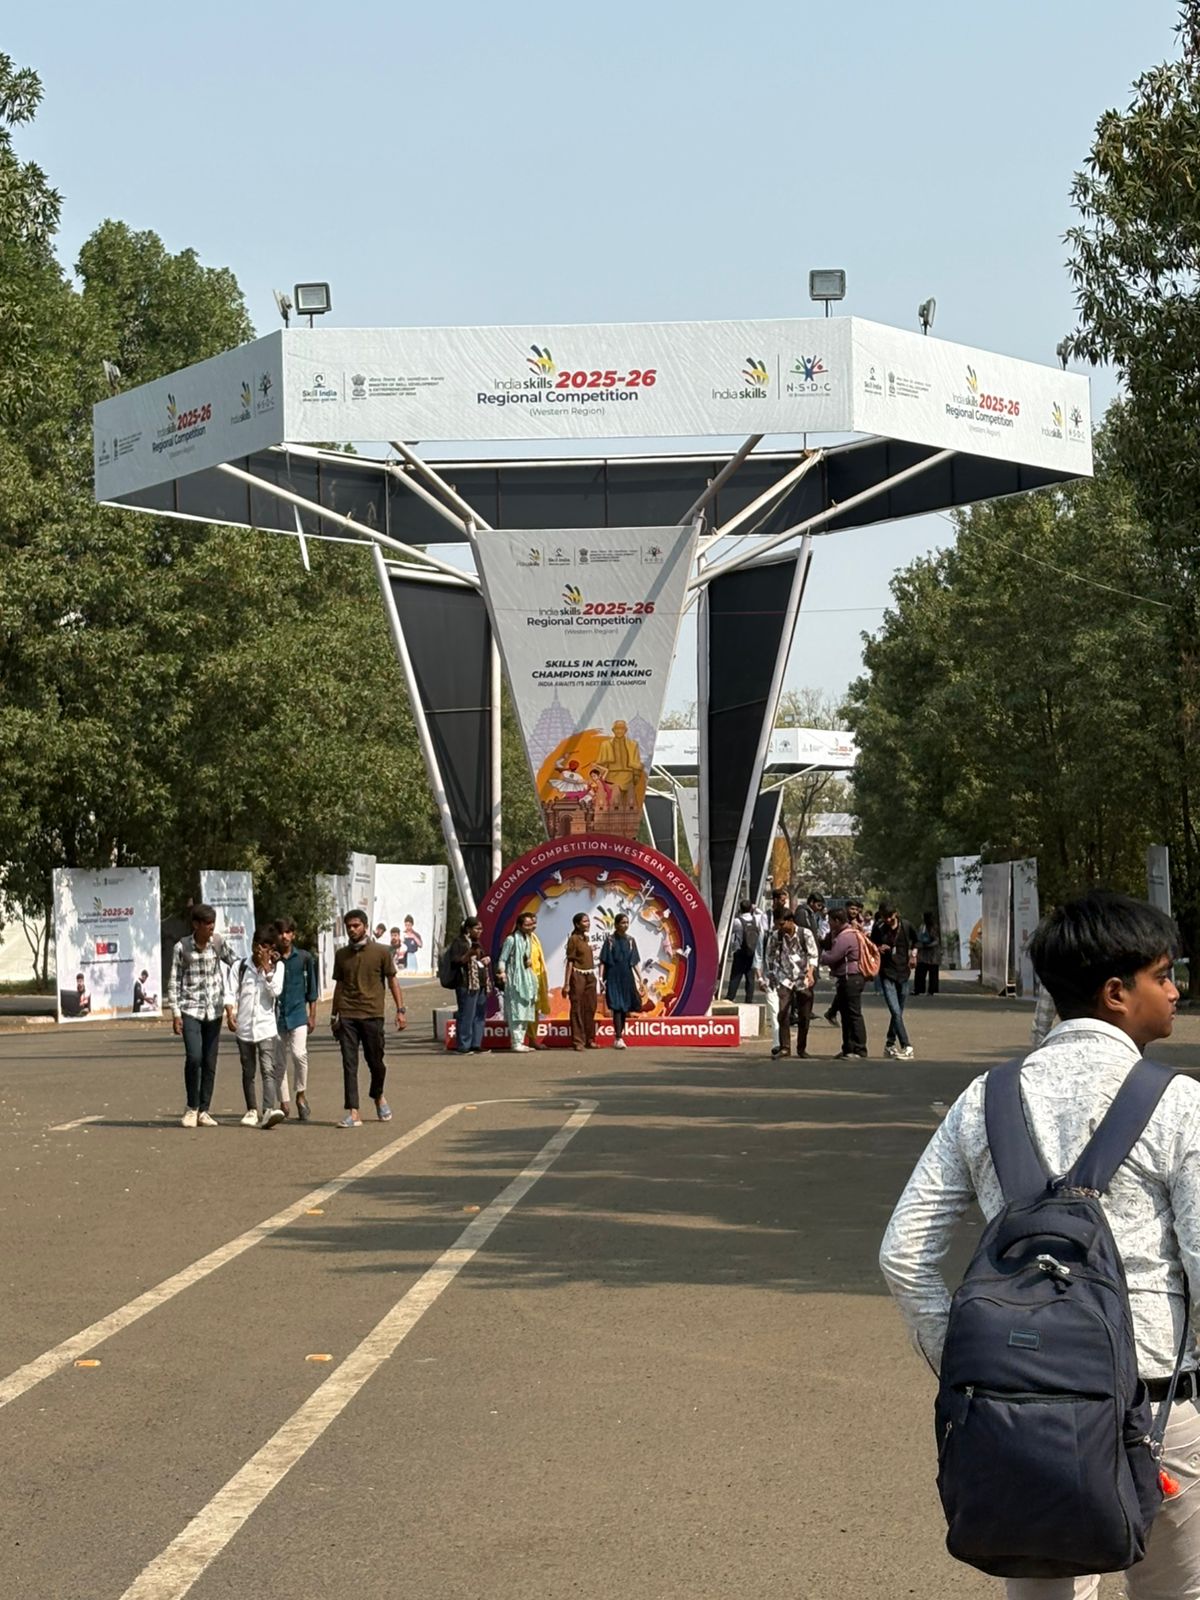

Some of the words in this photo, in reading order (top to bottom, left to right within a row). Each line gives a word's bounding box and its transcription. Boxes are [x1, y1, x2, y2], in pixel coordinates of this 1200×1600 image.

[555, 368, 657, 389] 2025-26
[477, 392, 543, 407] Regional
[545, 390, 638, 405] Competition
[979, 393, 1020, 416] 2025-26
[177, 404, 212, 430] 2025-26
[530, 408, 569, 418] (Western
[571, 406, 606, 417] Region)
[946, 403, 974, 419] Regional
[975, 410, 1014, 428] Competition
[152, 436, 174, 453] Regional
[174, 426, 206, 445] Competition
[583, 602, 655, 615] 2025-26
[527, 616, 573, 628] Regional
[576, 616, 642, 626] Competition
[545, 660, 580, 668] SKILLS
[582, 660, 594, 668] IN
[595, 660, 638, 668] ACTION,
[532, 670, 594, 678] CHAMPIONS
[597, 670, 609, 678] IN
[610, 669, 652, 678] MAKING
[486, 865, 530, 913] REGIONAL
[666, 870, 698, 910] REGION
[102, 908, 134, 916] 2025-26
